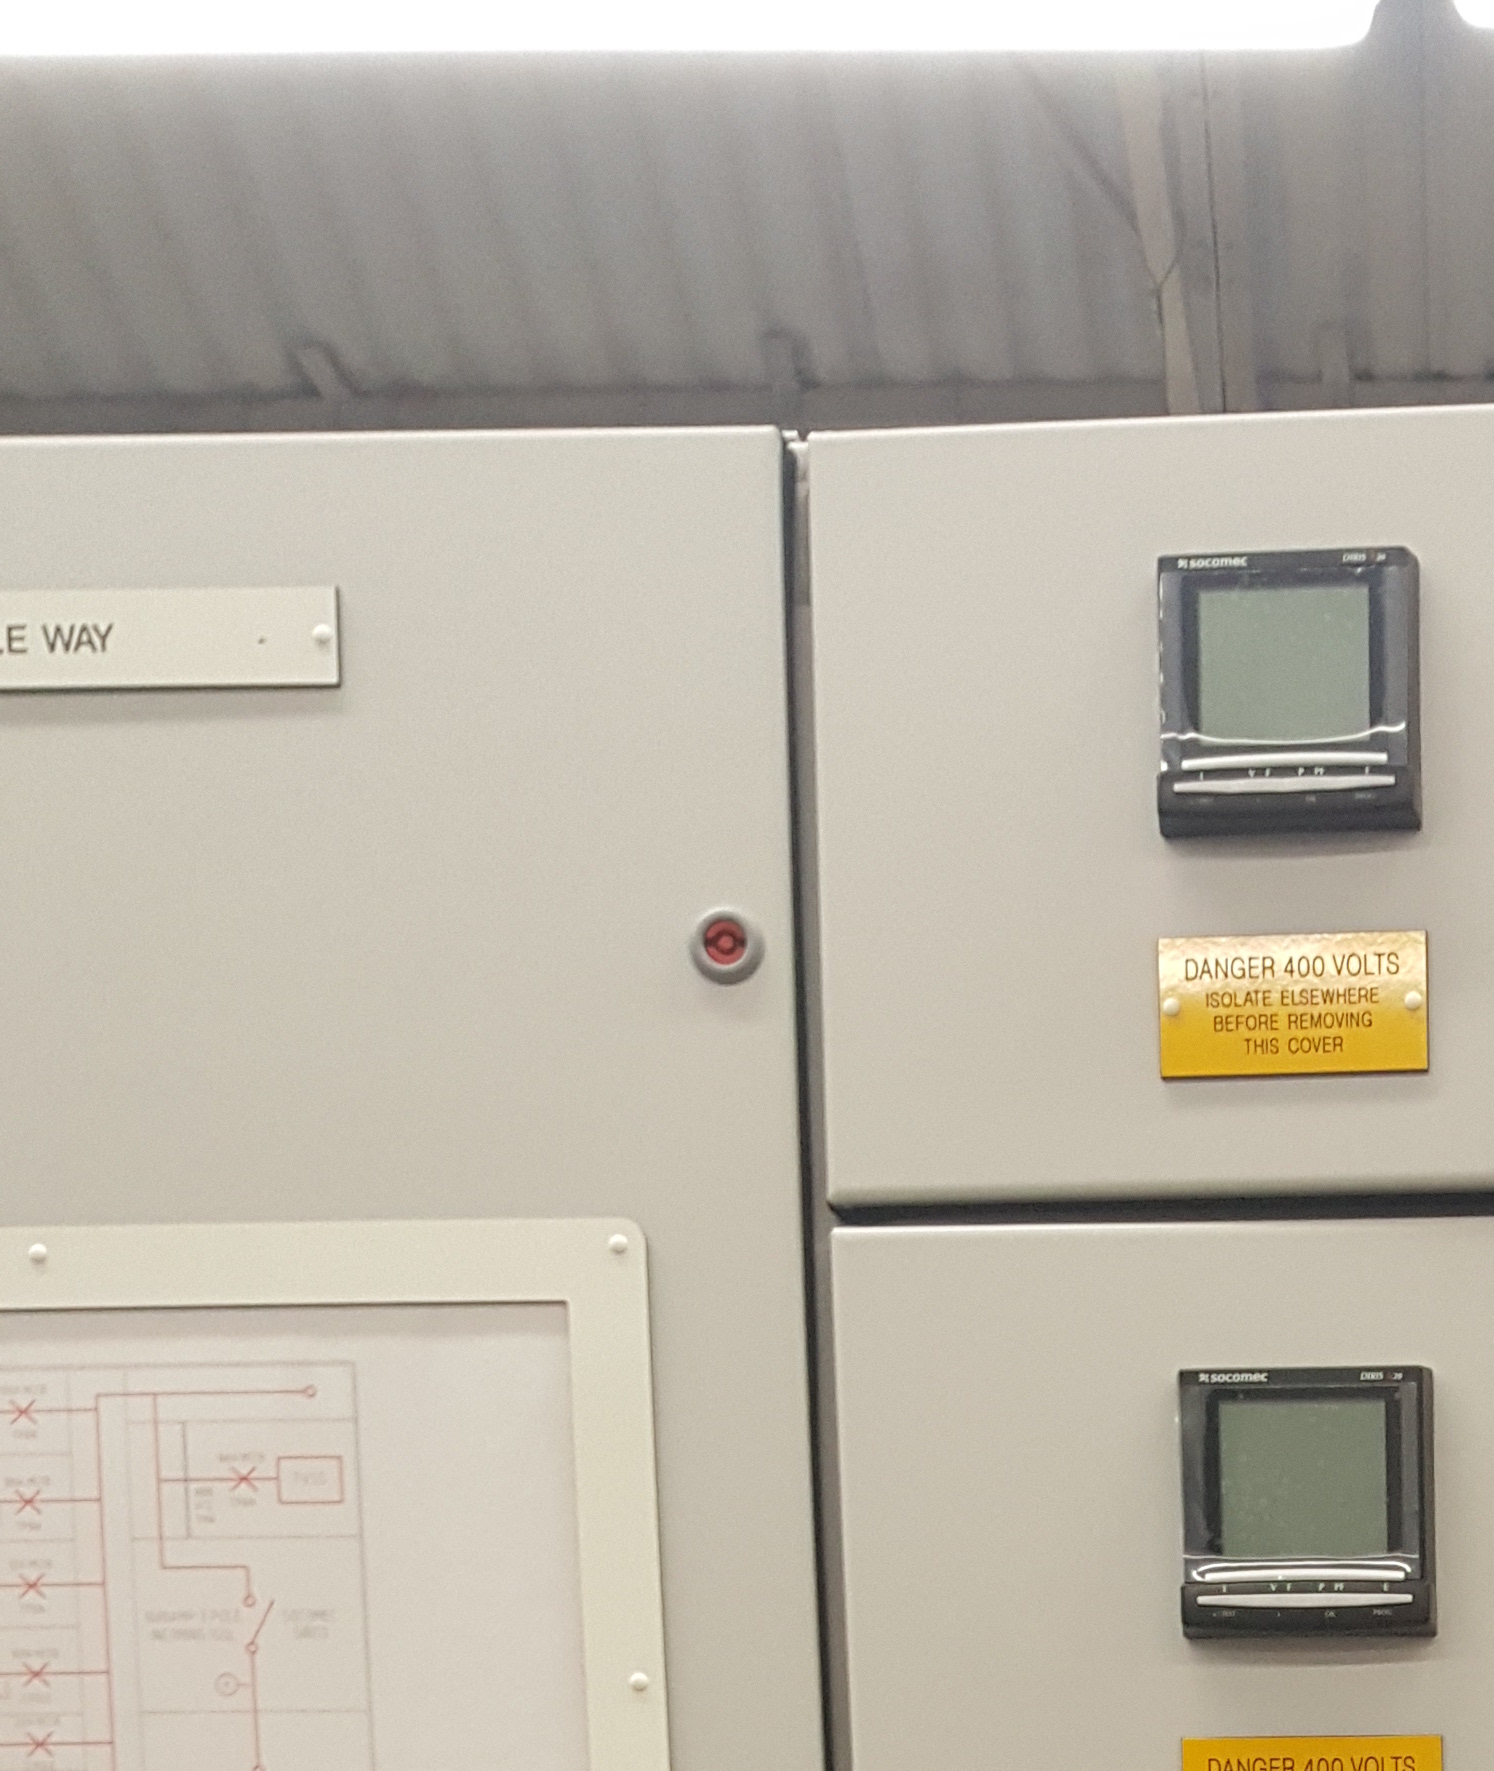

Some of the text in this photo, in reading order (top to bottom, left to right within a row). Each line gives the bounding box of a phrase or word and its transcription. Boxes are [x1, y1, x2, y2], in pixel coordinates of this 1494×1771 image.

[0, 623, 113, 654] E WAY
[1185, 952, 1400, 981] DANGER 400 VOLTS
[1206, 987, 1379, 1008] ISOLATE ELSEWHERE
[1214, 1012, 1372, 1032] BEFORE REMOVING
[1245, 1037, 1343, 1055] THIS COVER
[1210, 1372, 1268, 1382] socomec
